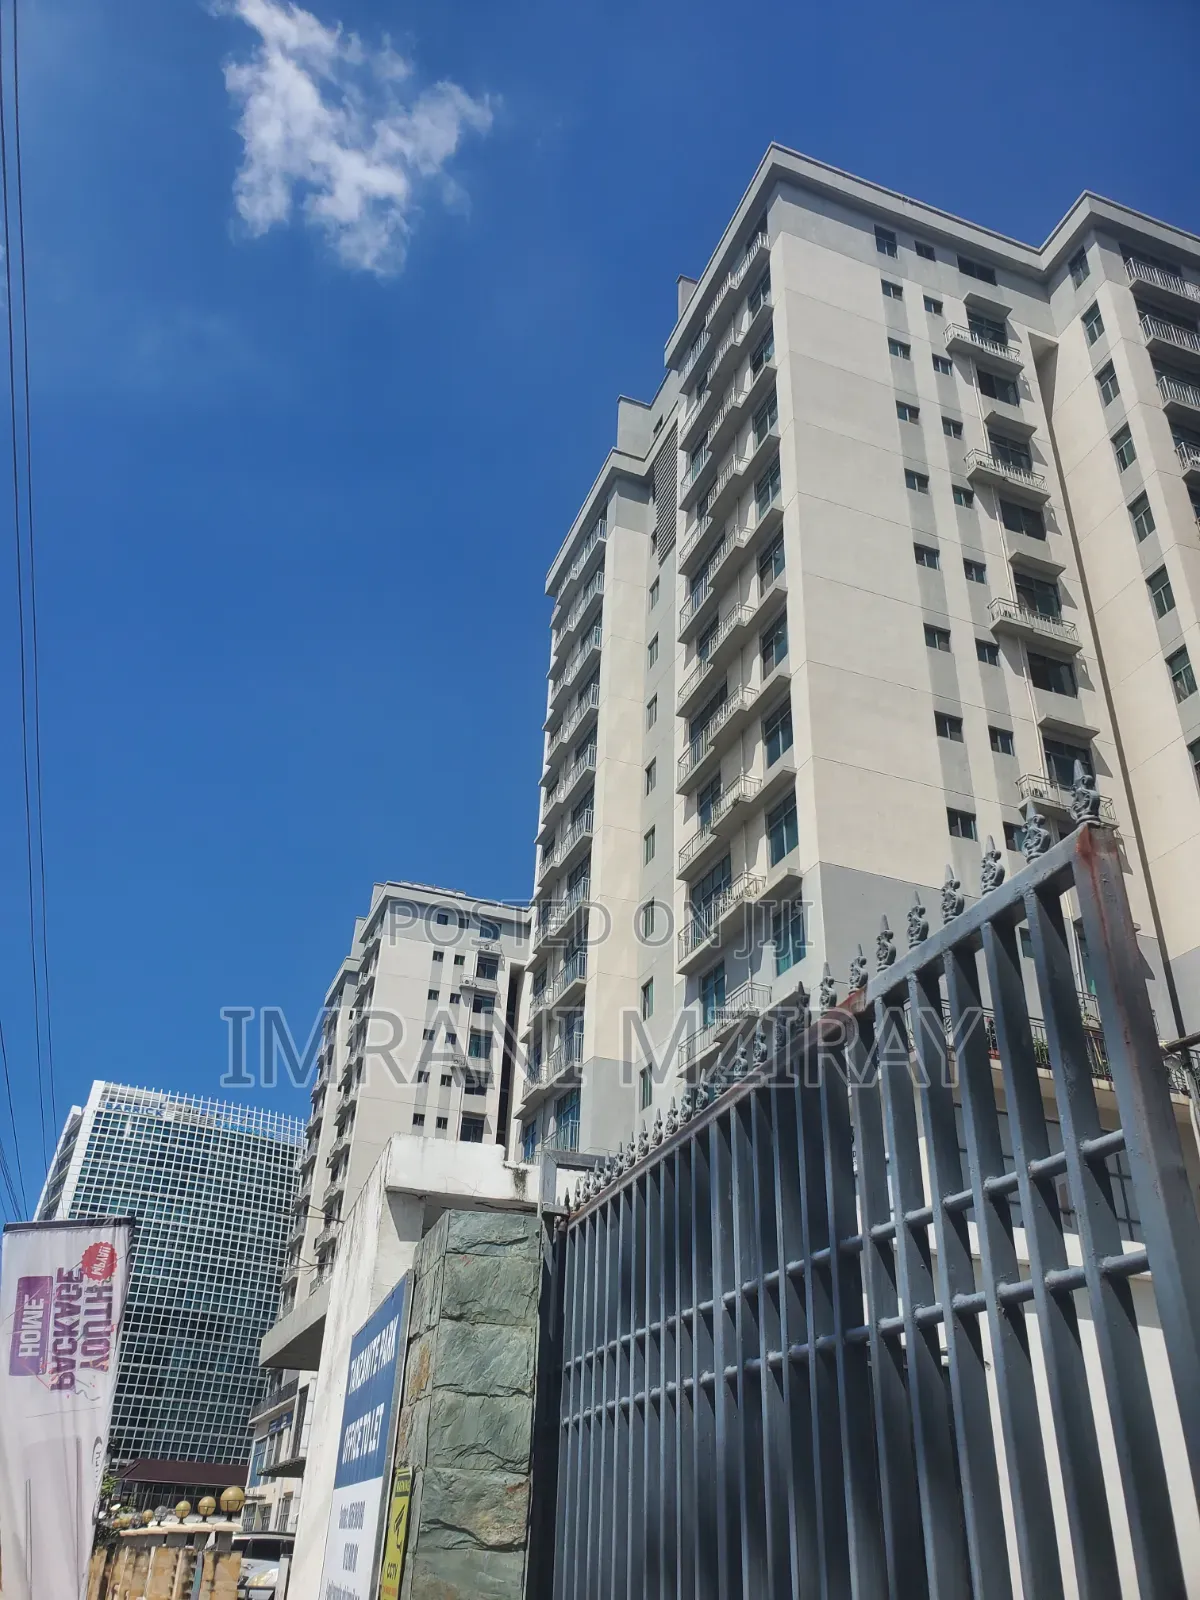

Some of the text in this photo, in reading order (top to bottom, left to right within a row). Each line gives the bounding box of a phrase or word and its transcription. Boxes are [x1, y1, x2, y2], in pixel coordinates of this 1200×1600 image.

[377, 1313, 400, 1372] PARK
[342, 1402, 385, 1465] OFFICE TO LET
[386, 1562, 399, 1580] CCTV
